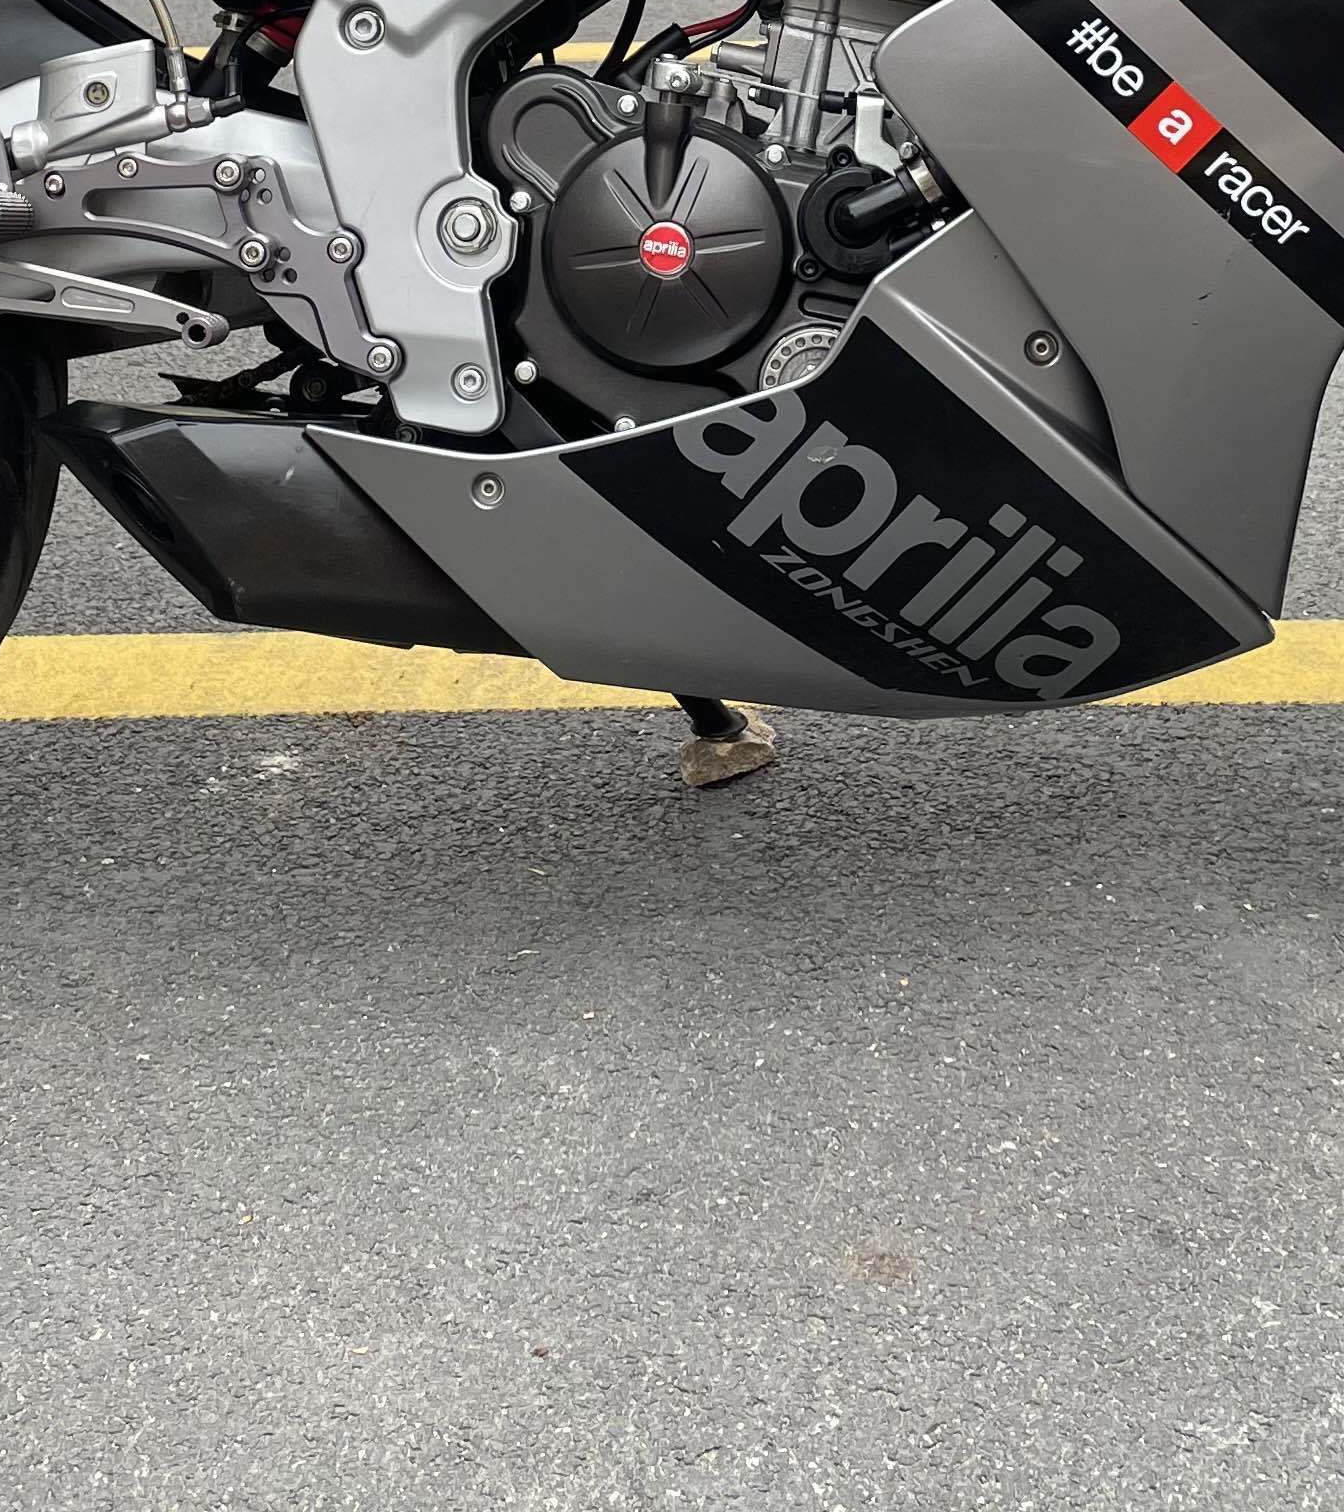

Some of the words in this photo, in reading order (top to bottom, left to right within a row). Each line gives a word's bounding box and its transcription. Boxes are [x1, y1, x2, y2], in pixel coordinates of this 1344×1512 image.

[1066, 17, 1144, 98] #be
[1157, 109, 1194, 145] a
[1204, 151, 1310, 245] racer
[643, 240, 686, 258] aprilia
[672, 390, 1121, 700] aprilia
[760, 546, 990, 688] ZONGSHEN
